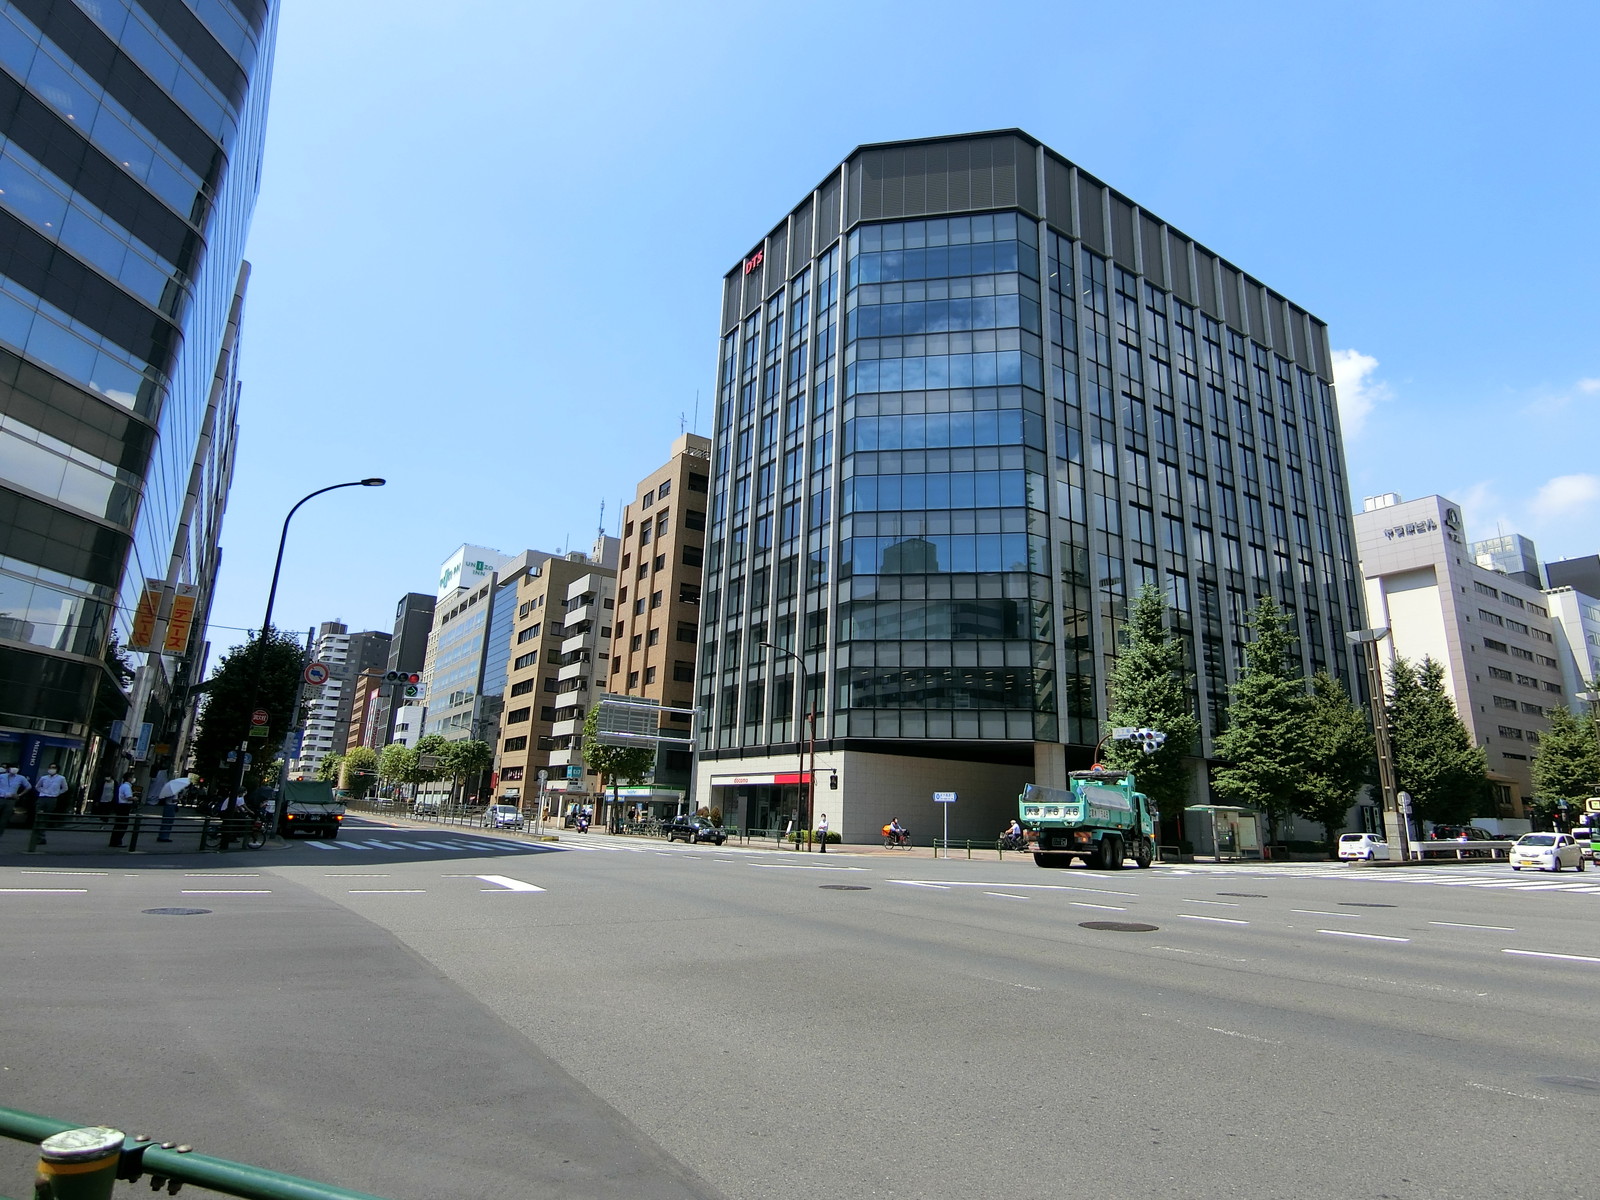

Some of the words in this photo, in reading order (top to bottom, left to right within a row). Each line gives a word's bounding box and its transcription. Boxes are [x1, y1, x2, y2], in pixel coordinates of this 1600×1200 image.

[745, 250, 763, 275] DTS
[465, 561, 494, 571] UNIZO
[167, 608, 193, 648] デニーズ
[29, 740, 41, 767] MIZUHO
